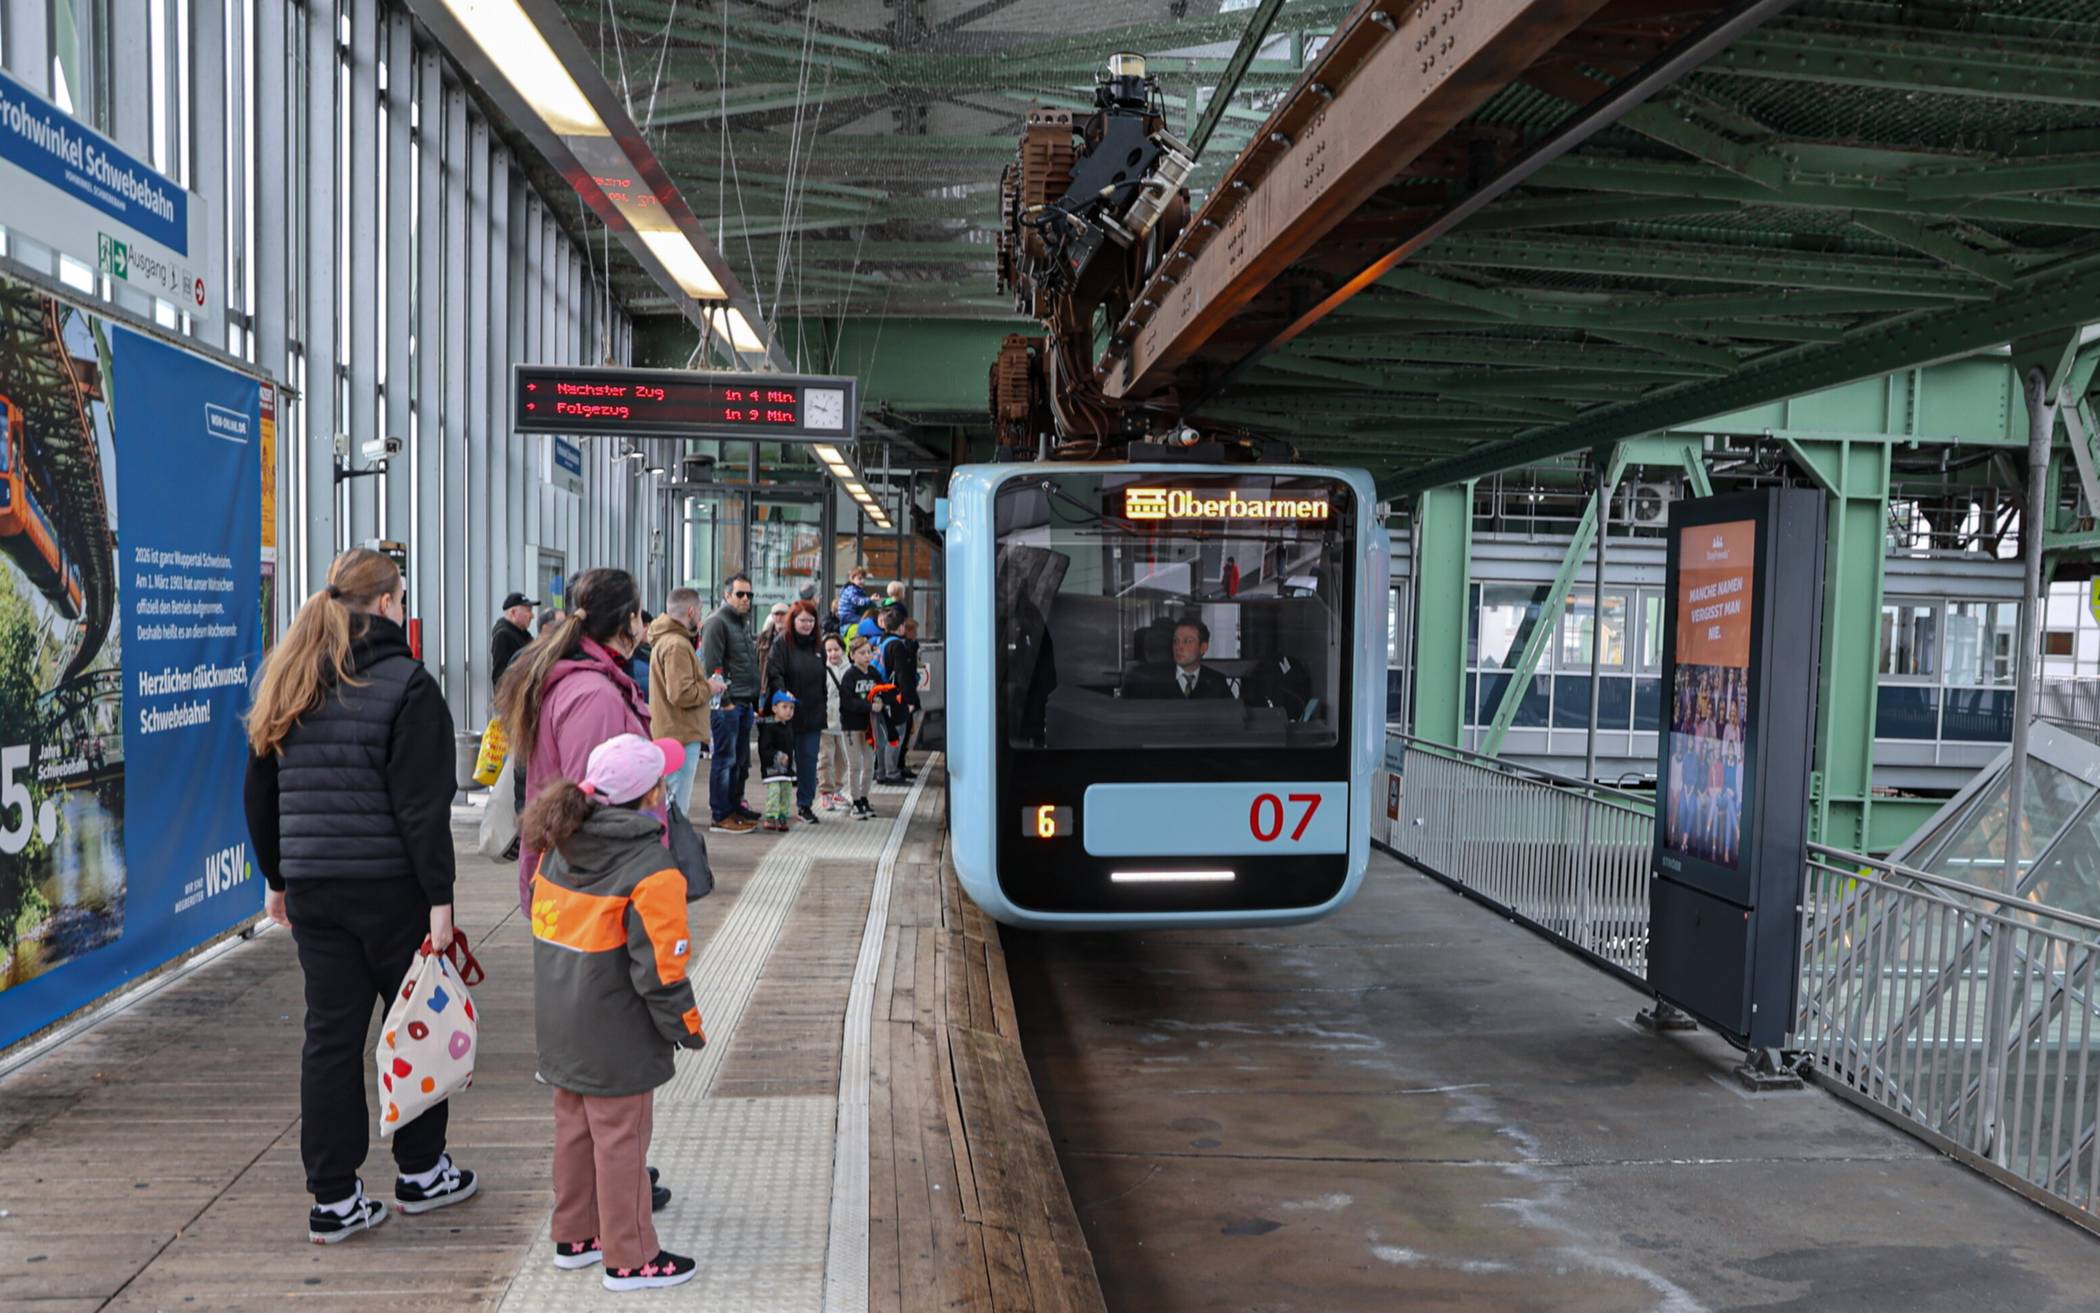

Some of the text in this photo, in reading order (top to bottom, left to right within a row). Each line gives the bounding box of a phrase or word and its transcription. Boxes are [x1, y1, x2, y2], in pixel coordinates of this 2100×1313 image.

[0, 89, 174, 223] rohwinkel Schwebebahn
[128, 244, 167, 287] Ausgang
[636, 385, 664, 401] Zug
[725, 389, 742, 401] in
[749, 390, 760, 402] 4
[768, 391, 796, 403] Min.
[557, 402, 796, 422] Folgezug in 9 Min.
[1168, 490, 1328, 518] Oberbarmen
[135, 546, 151, 563] 2026
[151, 548, 159, 564] ist
[159, 552, 174, 569] ganz
[174, 551, 202, 570] Wuppertal
[136, 573, 147, 589] Am
[148, 574, 154, 590] 1.
[154, 573, 169, 590] März
[170, 575, 183, 590] 1901
[184, 575, 193, 591] hat
[1689, 576, 1744, 604] MANCHE NAMEN
[136, 598, 159, 615] offiziell
[159, 599, 171, 615] den
[171, 599, 192, 615] Betrieb
[1691, 599, 1742, 624] VERGISST MAN
[137, 624, 162, 641] Deshalb
[163, 623, 177, 640] heißt
[178, 627, 185, 639] es
[1708, 624, 1721, 641] NIE.
[139, 660, 248, 697] Herzlichen Glückwunsch,
[140, 698, 211, 735] Schwebebahn!
[38, 742, 89, 781] Jahre Schwebebahn
[1038, 805, 1056, 838] 6
[1250, 793, 1322, 842] 07
